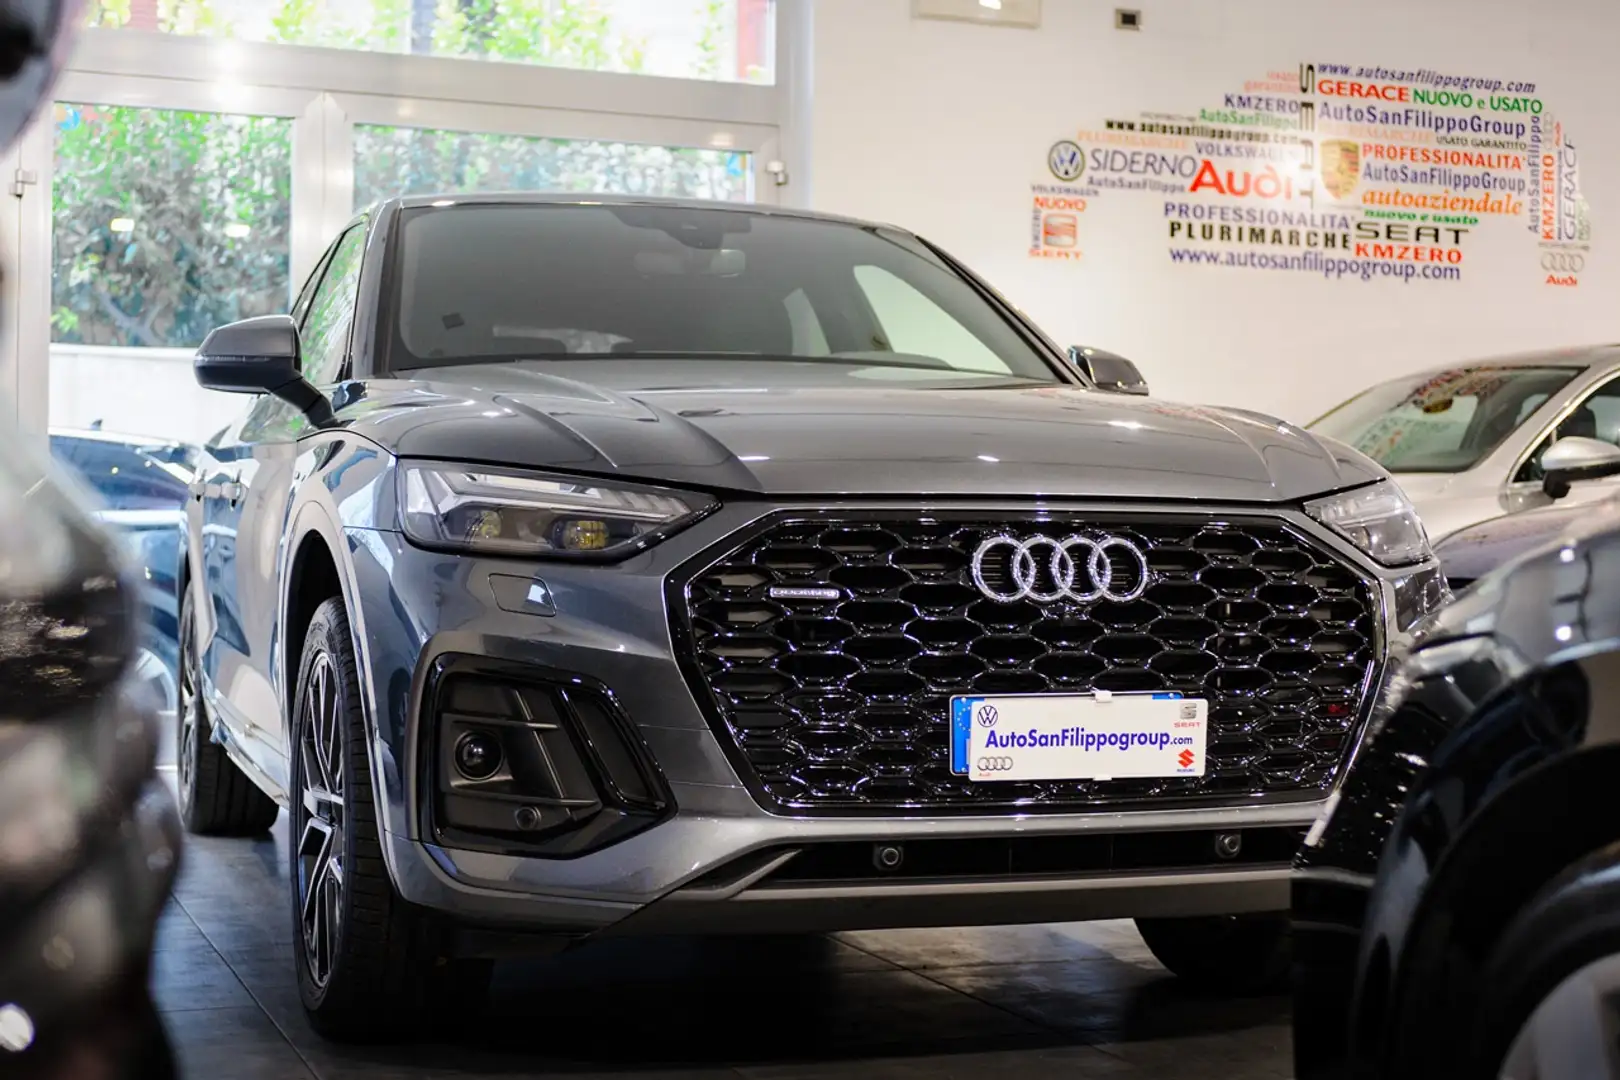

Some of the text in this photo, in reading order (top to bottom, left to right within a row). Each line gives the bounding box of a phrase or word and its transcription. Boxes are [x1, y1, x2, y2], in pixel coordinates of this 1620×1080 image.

[1318, 63, 1535, 93] www.autosanfilippogroup.com
[1224, 94, 1299, 113] KMZERO
[1319, 80, 1542, 113] GERACE NUOVO e USATO
[1199, 108, 1299, 129] AutoSanFilippo
[1319, 103, 1525, 138] AutoSanFilippoGroup
[1106, 120, 1301, 143] www.autosanfilippogroup.com
[1436, 136, 1526, 151] USATO GARANTITO
[1090, 149, 1196, 178] SIDERNO
[1363, 144, 1526, 169] PROFESSIONALITA'
[1087, 177, 1185, 194] AutoSanFilippo
[1189, 160, 1292, 199] Audi
[1363, 165, 1525, 192] AutoSanFilippoGroup
[1528, 116, 1540, 232] AutoSanFilippo
[1035, 197, 1087, 212] NUOVO
[1362, 190, 1522, 215] autoaziendale
[1543, 155, 1554, 239] KMZERO
[1365, 209, 1479, 225] nuovo e usato
[1170, 222, 1350, 249] PLURIMARCHE
[1357, 222, 1469, 244] SEAT
[1170, 249, 1460, 280] www.autosanfilippogroup.com
[1355, 244, 1462, 263] KMZERO
[985, 728, 1193, 751] AutoSanFilippogroup.com
